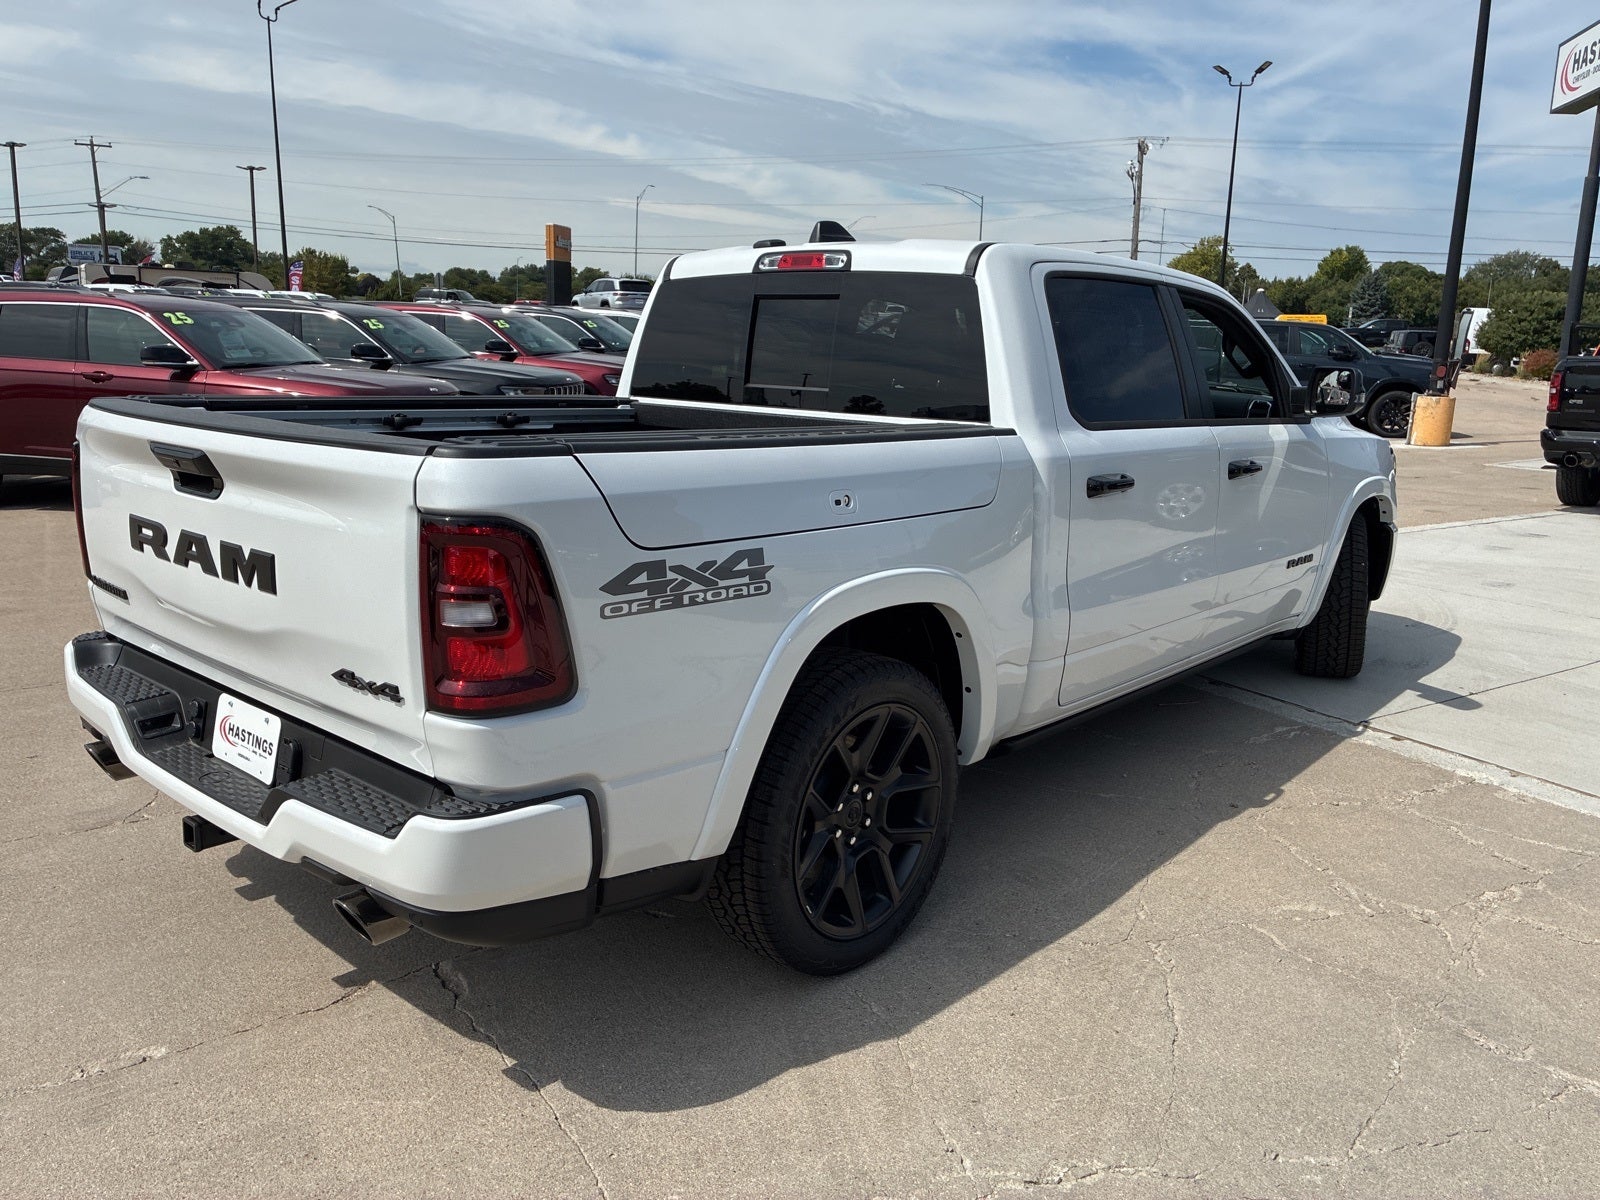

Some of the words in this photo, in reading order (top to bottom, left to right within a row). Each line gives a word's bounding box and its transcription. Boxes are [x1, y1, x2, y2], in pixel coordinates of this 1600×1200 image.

[162, 311, 195, 325] 25
[362, 318, 385, 330] 25
[493, 319, 511, 329] 25
[583, 319, 598, 328] 25
[128, 513, 278, 596] RAM
[1286, 553, 1314, 570] RAM
[603, 596, 674, 617] OFF
[682, 582, 768, 605] ROAD
[227, 721, 274, 757] HASTINGS
